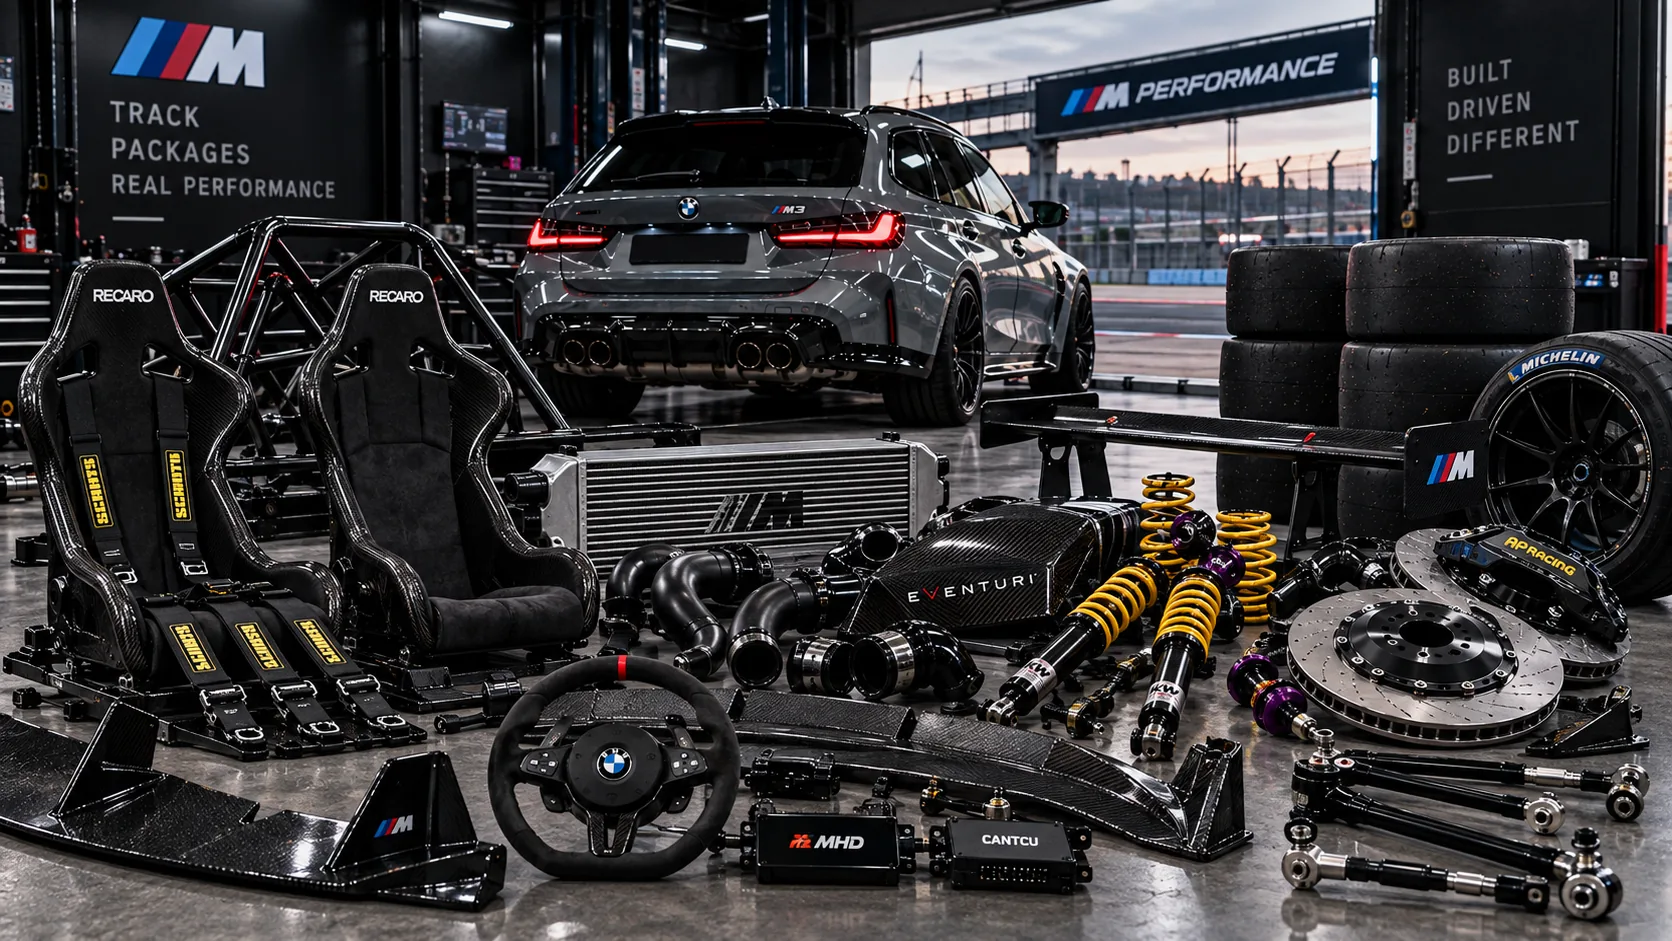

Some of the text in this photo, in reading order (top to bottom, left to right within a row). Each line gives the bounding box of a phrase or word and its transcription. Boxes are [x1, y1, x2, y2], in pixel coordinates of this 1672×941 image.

[1135, 52, 1339, 103] PERFORMANCE
[1447, 58, 1512, 88] BUILT
[109, 100, 200, 128] TRACK
[1447, 91, 1531, 122] DRIVEN
[1447, 119, 1580, 155] DIFFERENT
[111, 137, 250, 165] PACKAGES
[111, 173, 336, 199] REAL PERFORMANCE
[782, 205, 806, 214] M3
[93, 288, 154, 303] RECARO
[369, 289, 424, 304] RECARO
[1521, 350, 1601, 375] MICHELIN
[907, 573, 1034, 603] EVENTURI
[813, 834, 865, 850] MHD
[981, 834, 1039, 847] CANTCU
